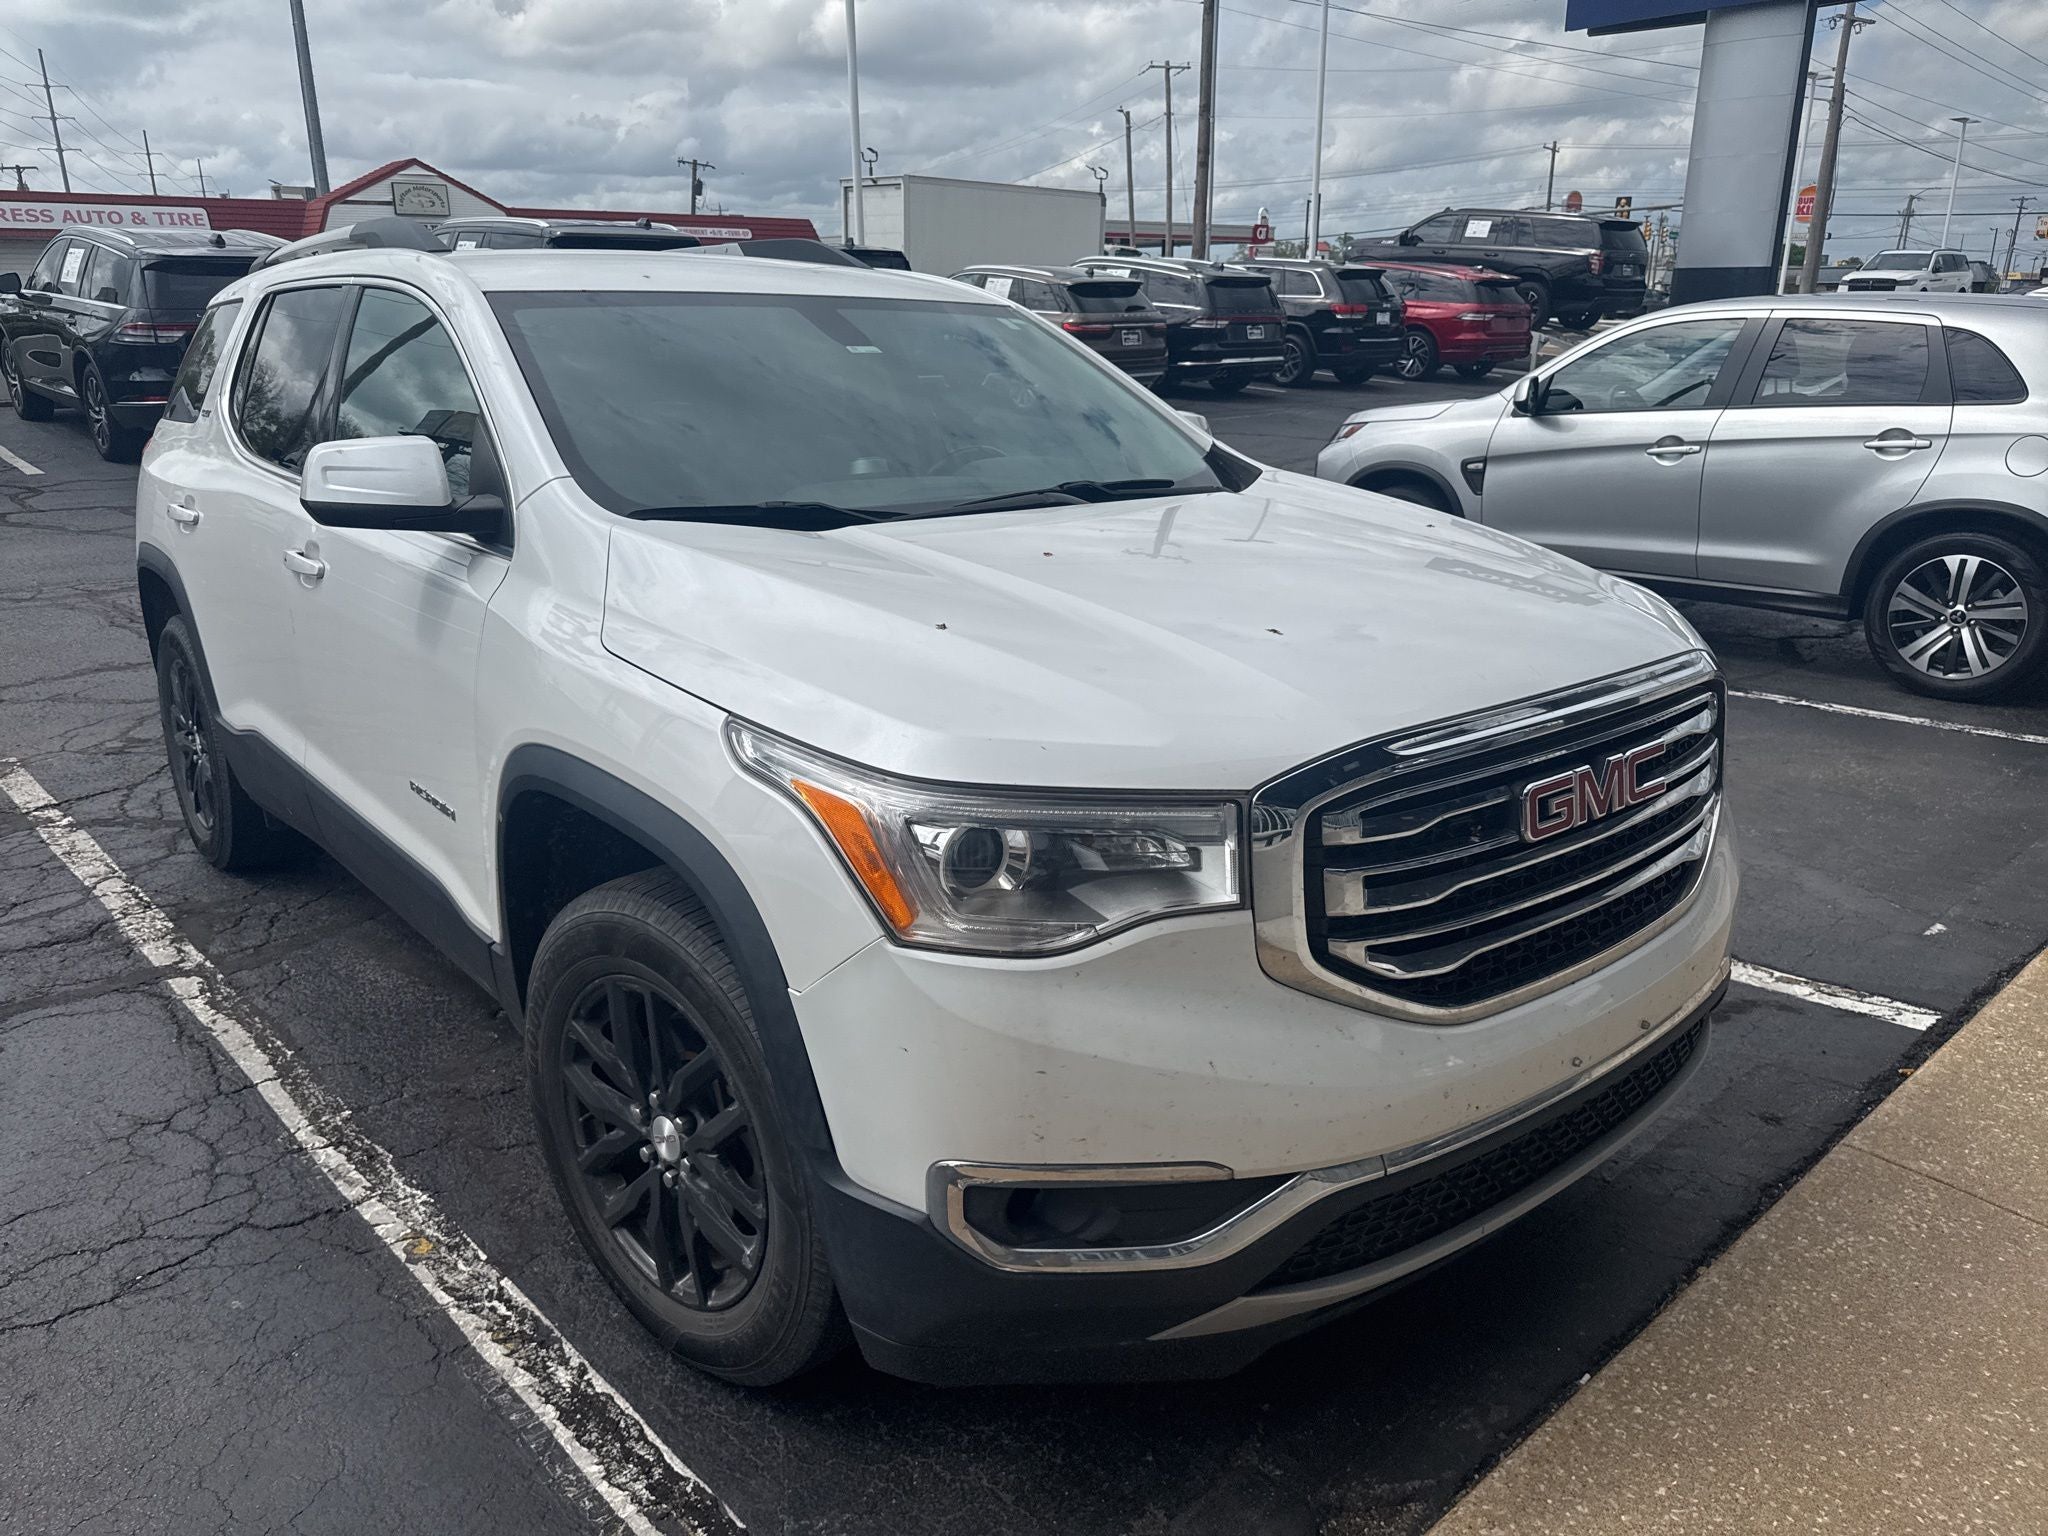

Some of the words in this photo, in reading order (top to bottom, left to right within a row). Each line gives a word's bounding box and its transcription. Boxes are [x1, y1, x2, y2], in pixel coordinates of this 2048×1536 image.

[62, 209, 124, 225] AUTO
[131, 211, 148, 226] &
[152, 211, 206, 227] TIRE
[1522, 738, 1667, 844] GMC
